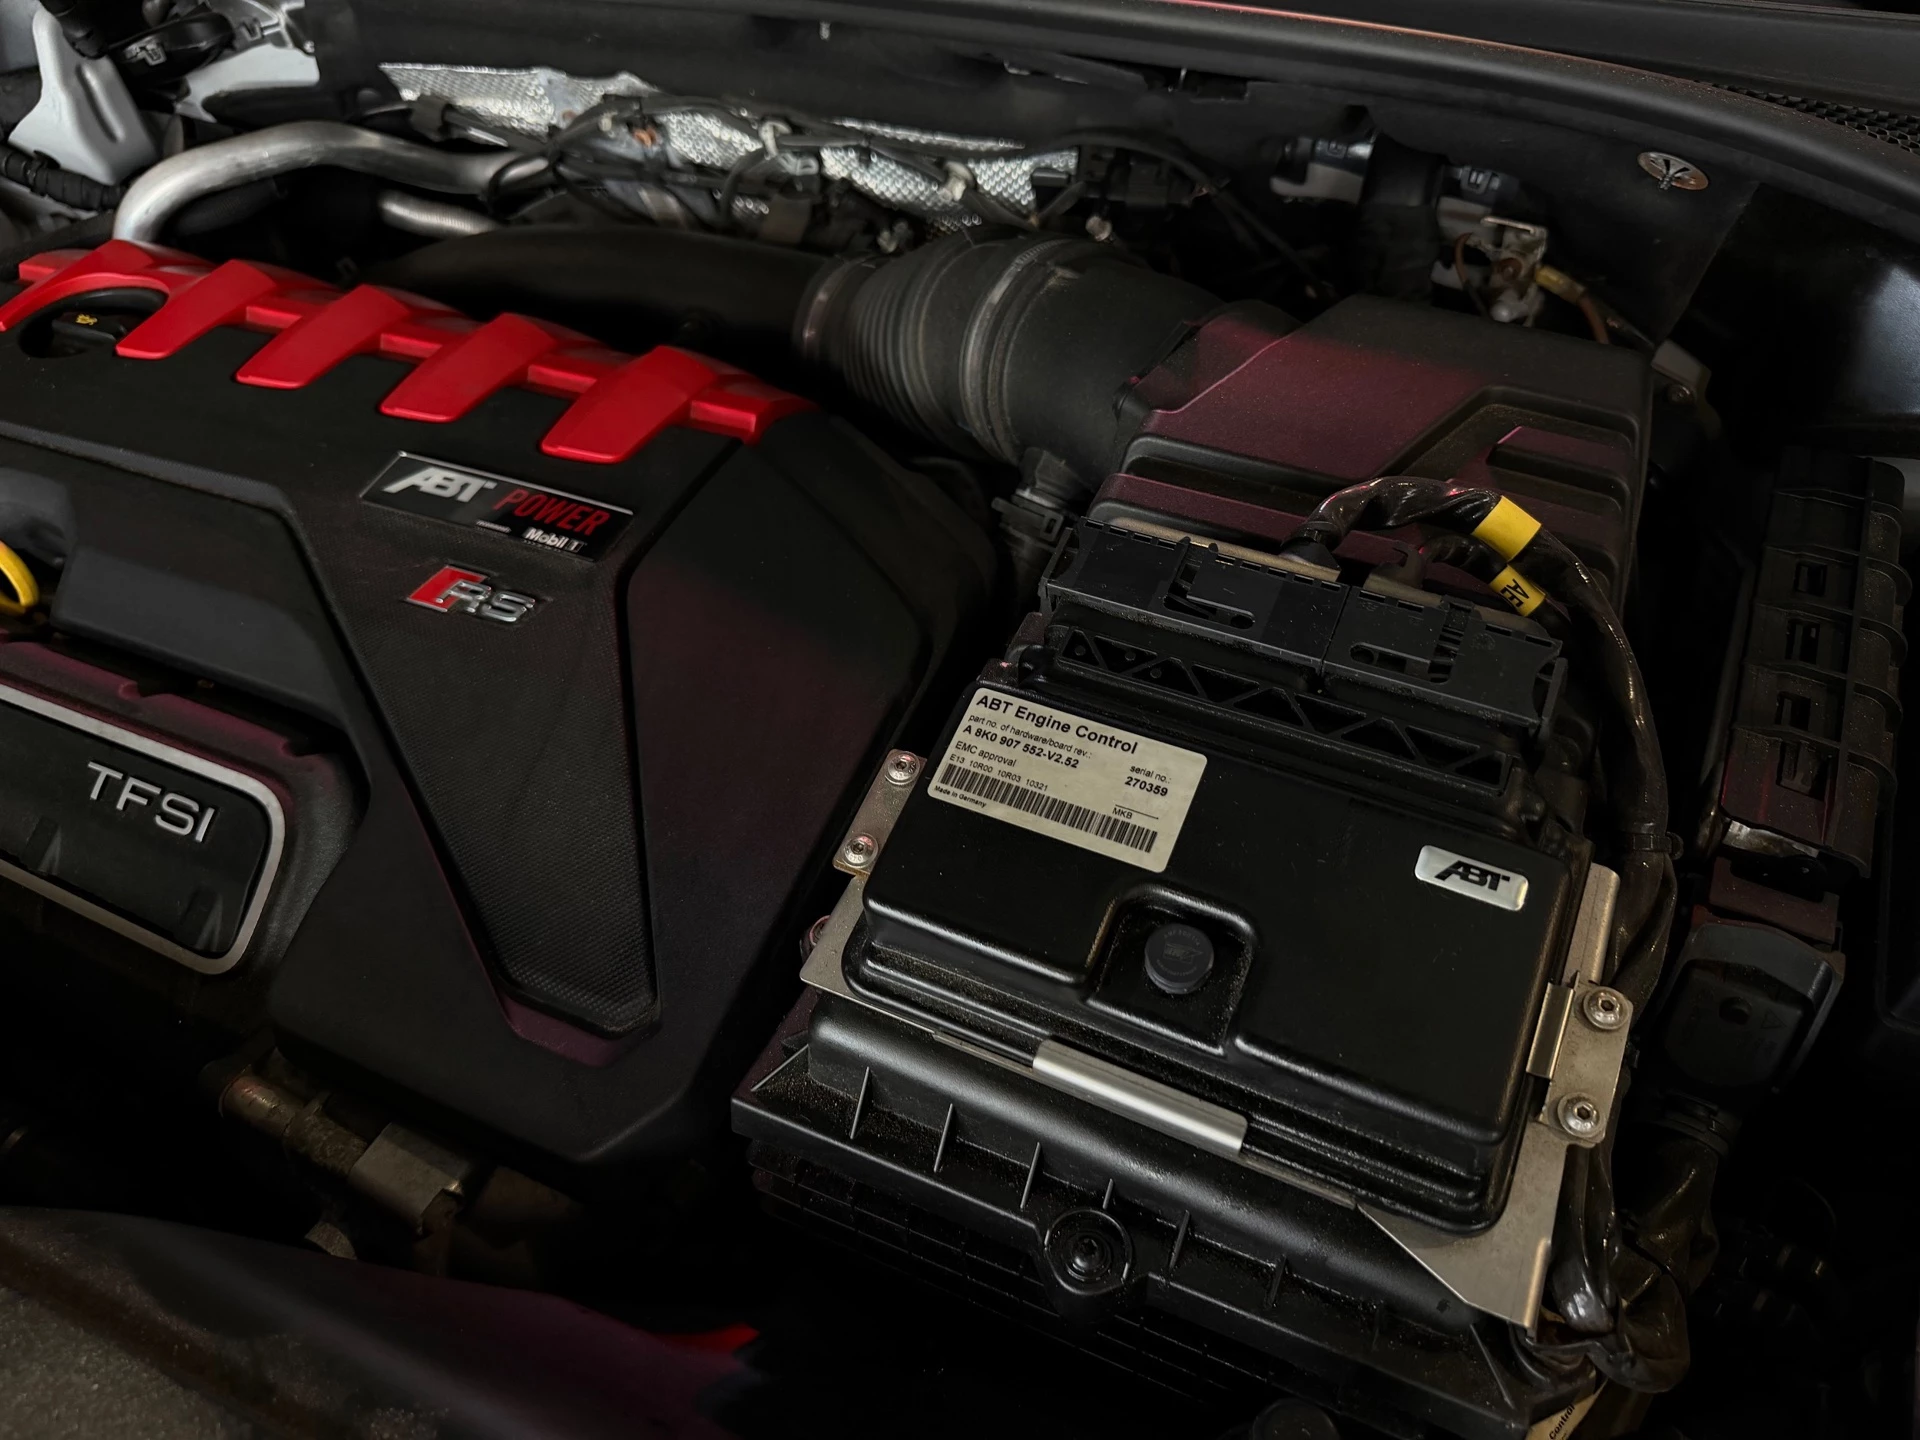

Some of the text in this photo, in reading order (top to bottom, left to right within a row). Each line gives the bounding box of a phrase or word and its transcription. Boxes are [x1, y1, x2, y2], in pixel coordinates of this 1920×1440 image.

[381, 467, 613, 537] ABT POWER
[523, 526, 569, 550] Mobil
[428, 578, 537, 623] RS
[968, 714, 985, 724] part
[985, 719, 998, 729] no.
[1010, 726, 1073, 752] hardware/board
[976, 695, 1138, 754] ABT Engine Control
[955, 740, 1017, 768] EMC approval
[963, 725, 1080, 769] A 8K0 907 552-V2.52
[949, 753, 1048, 792] E13 10R00 10R03 10321
[1124, 776, 1169, 797] 270359
[1129, 765, 1154, 778] serial
[88, 761, 216, 843] TFSI
[934, 785, 951, 795] Made
[958, 793, 987, 808] Germany
[1112, 807, 1133, 820] MKB
[1434, 859, 1511, 891] ABT
